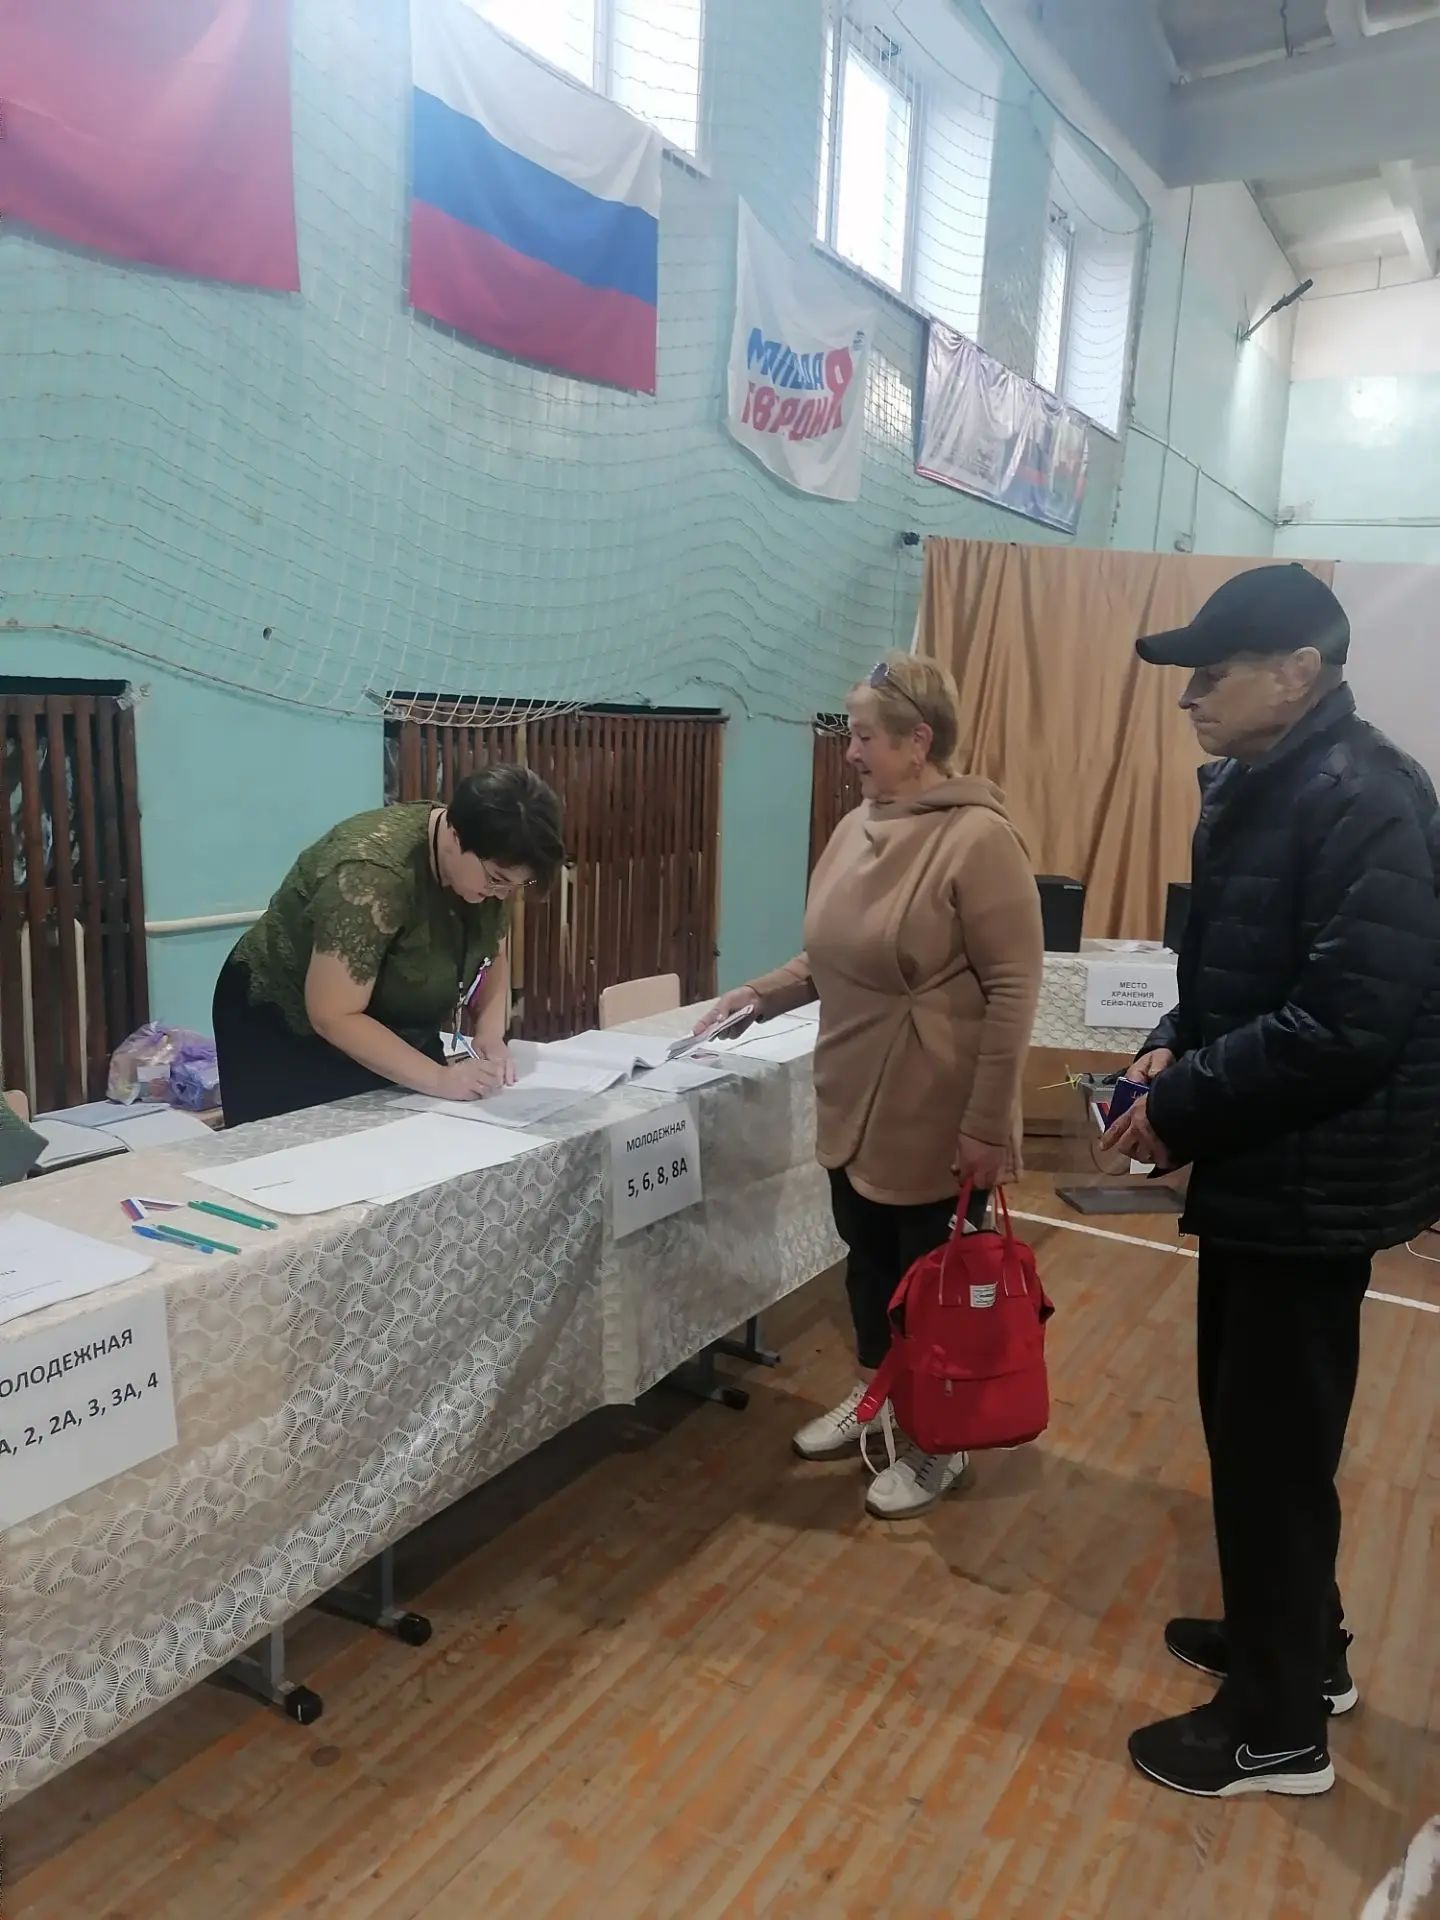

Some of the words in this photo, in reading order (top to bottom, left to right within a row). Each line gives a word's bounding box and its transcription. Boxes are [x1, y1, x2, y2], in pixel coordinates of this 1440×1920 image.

[741, 382, 842, 441] ГВРДИЯ
[1120, 981, 1148, 989] МЕСТО
[1101, 999, 1164, 1008] СЕЙФ-ПАКЕТОВ
[626, 1120, 686, 1152] МОЛОДЕЖНАЯ
[628, 1179, 639, 1198] 5,
[642, 1172, 654, 1191] 6,
[657, 1166, 669, 1184] 8,
[671, 1157, 688, 1178] 8А
[24, 1426, 43, 1446] 2,
[49, 1410, 83, 1435] 2А,
[88, 1399, 106, 1416] 3,
[111, 1383, 142, 1407] 3А,
[147, 1372, 159, 1388] 4
